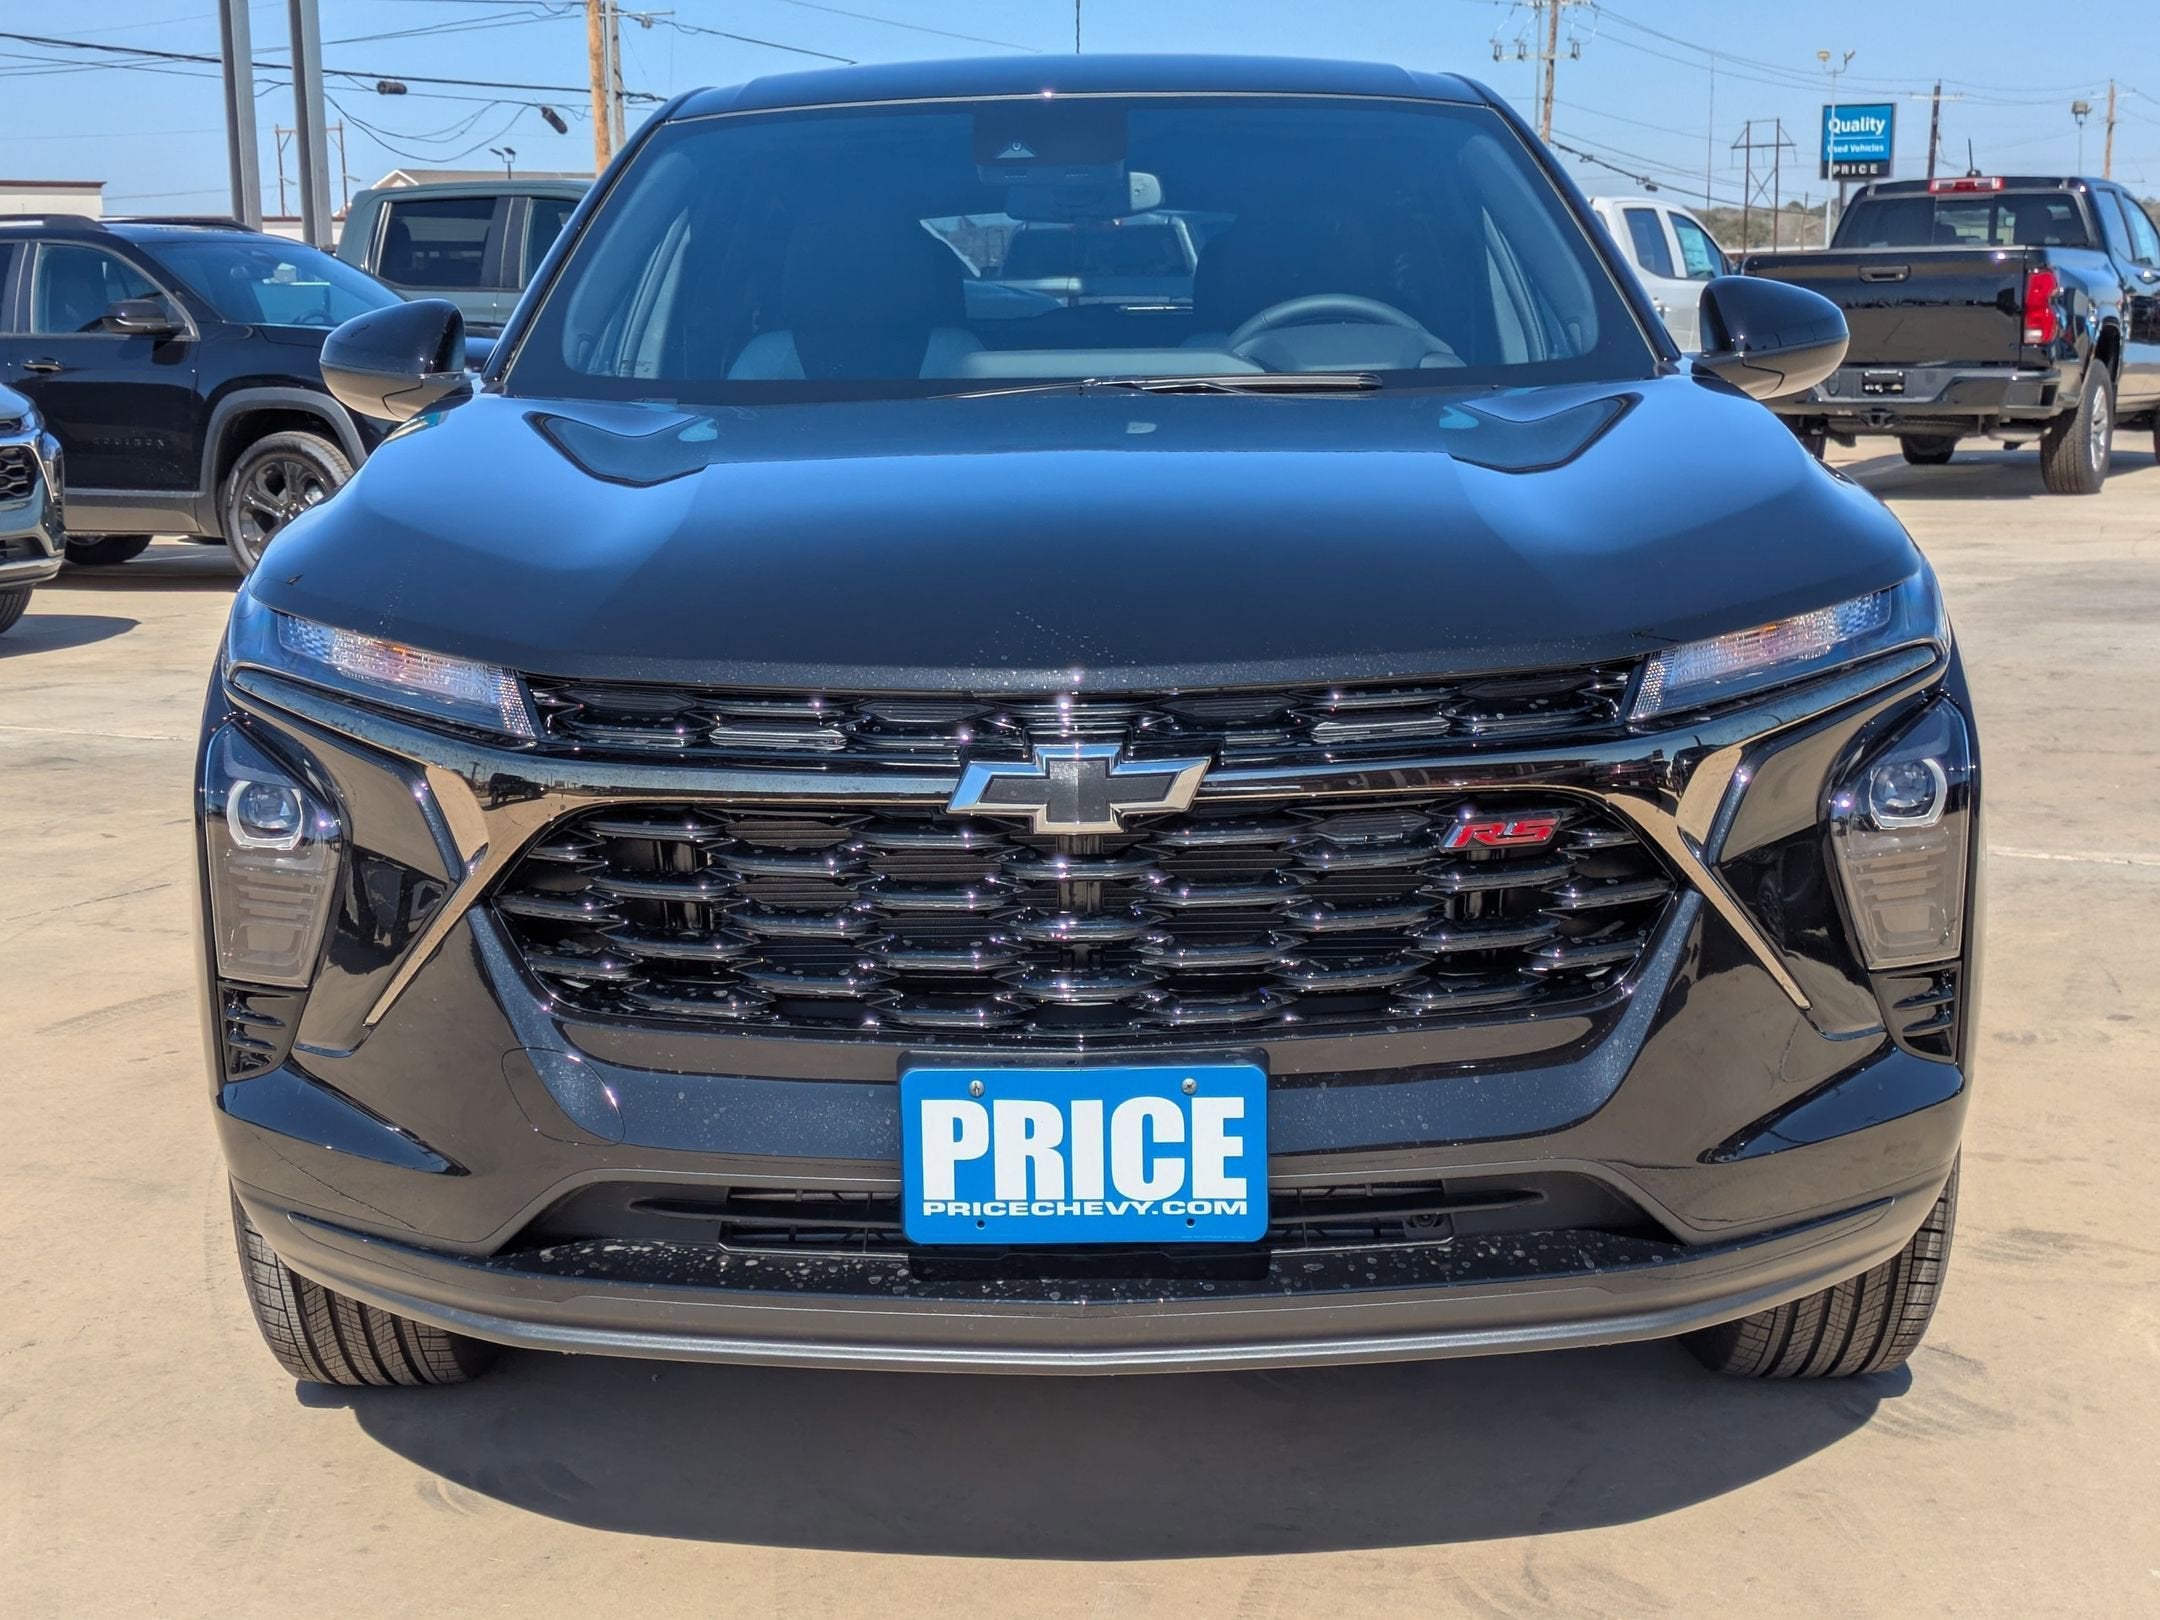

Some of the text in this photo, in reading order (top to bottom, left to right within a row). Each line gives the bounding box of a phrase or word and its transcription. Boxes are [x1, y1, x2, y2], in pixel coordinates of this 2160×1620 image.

[1828, 117, 1885, 135] Quality
[1850, 144, 1884, 152] Vehicles
[1832, 164, 1878, 174] PRICE
[1445, 819, 1557, 848] RS
[921, 1096, 1247, 1200] PRICE
[923, 1200, 1247, 1216] PRICECHEVY.COM
